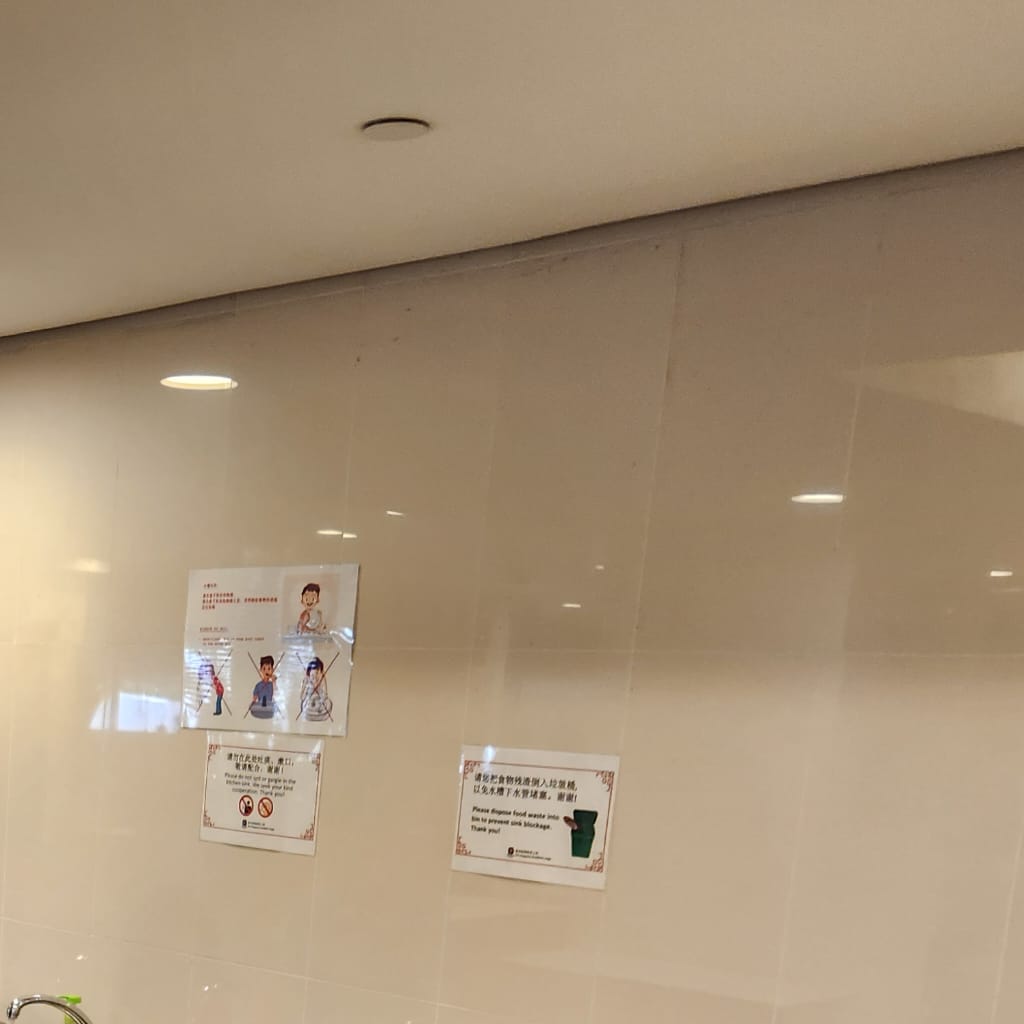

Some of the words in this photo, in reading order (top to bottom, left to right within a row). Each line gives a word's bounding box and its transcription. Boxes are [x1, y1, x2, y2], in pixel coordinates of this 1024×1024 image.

[472, 806, 490, 814] Please
[491, 808, 512, 817] dispose
[513, 809, 527, 818] food
[547, 812, 560, 821] into
[471, 824, 487, 832] Thank
[488, 826, 500, 834] you!
[488, 818, 510, 826] prevent
[511, 819, 522, 827] sink
[523, 819, 552, 830] blockage.
